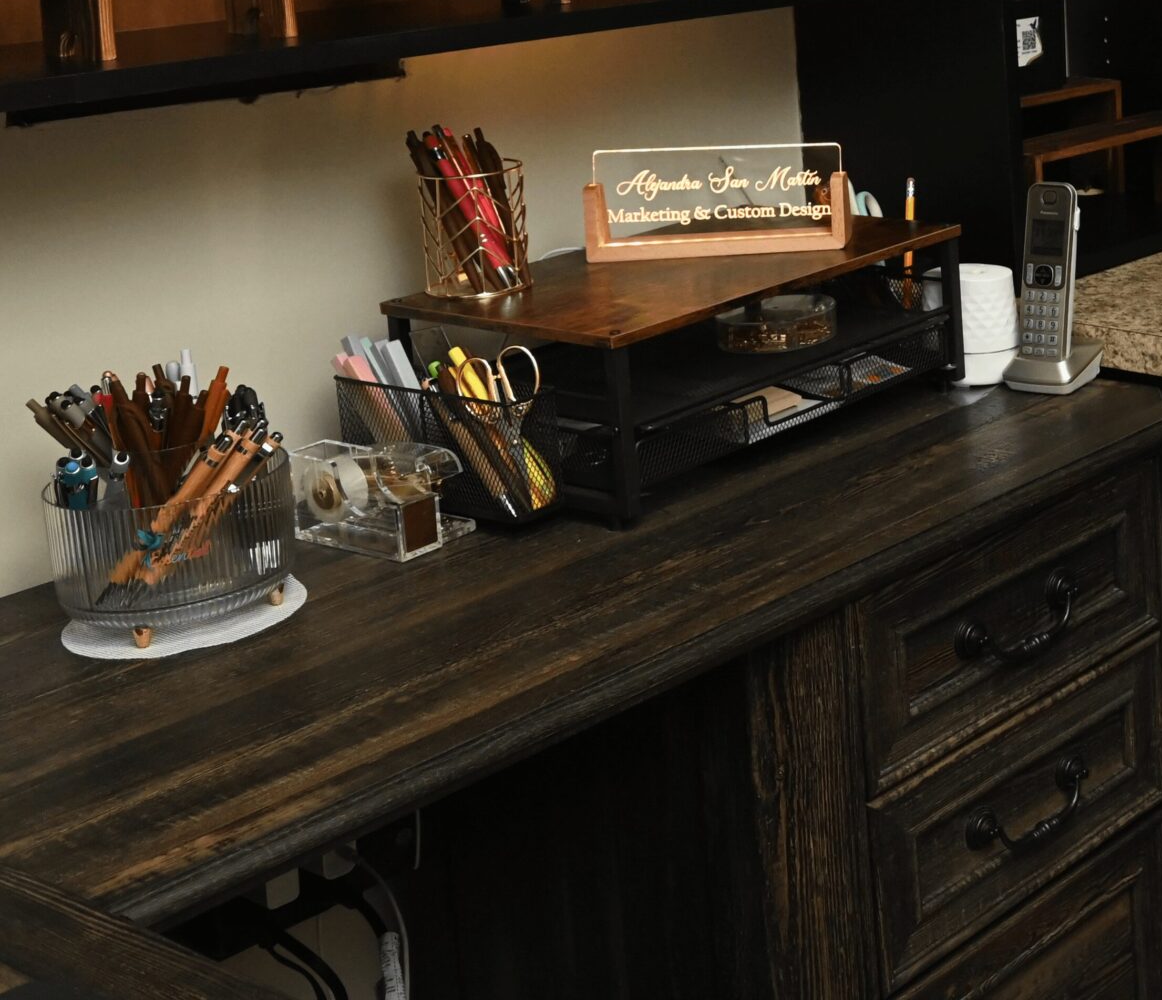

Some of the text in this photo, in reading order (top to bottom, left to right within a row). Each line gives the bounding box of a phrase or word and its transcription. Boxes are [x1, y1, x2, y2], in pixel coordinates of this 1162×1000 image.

[616, 169, 703, 202] Alejandra
[708, 166, 749, 194] San
[607, 202, 832, 226] Marketing & Custom Design
